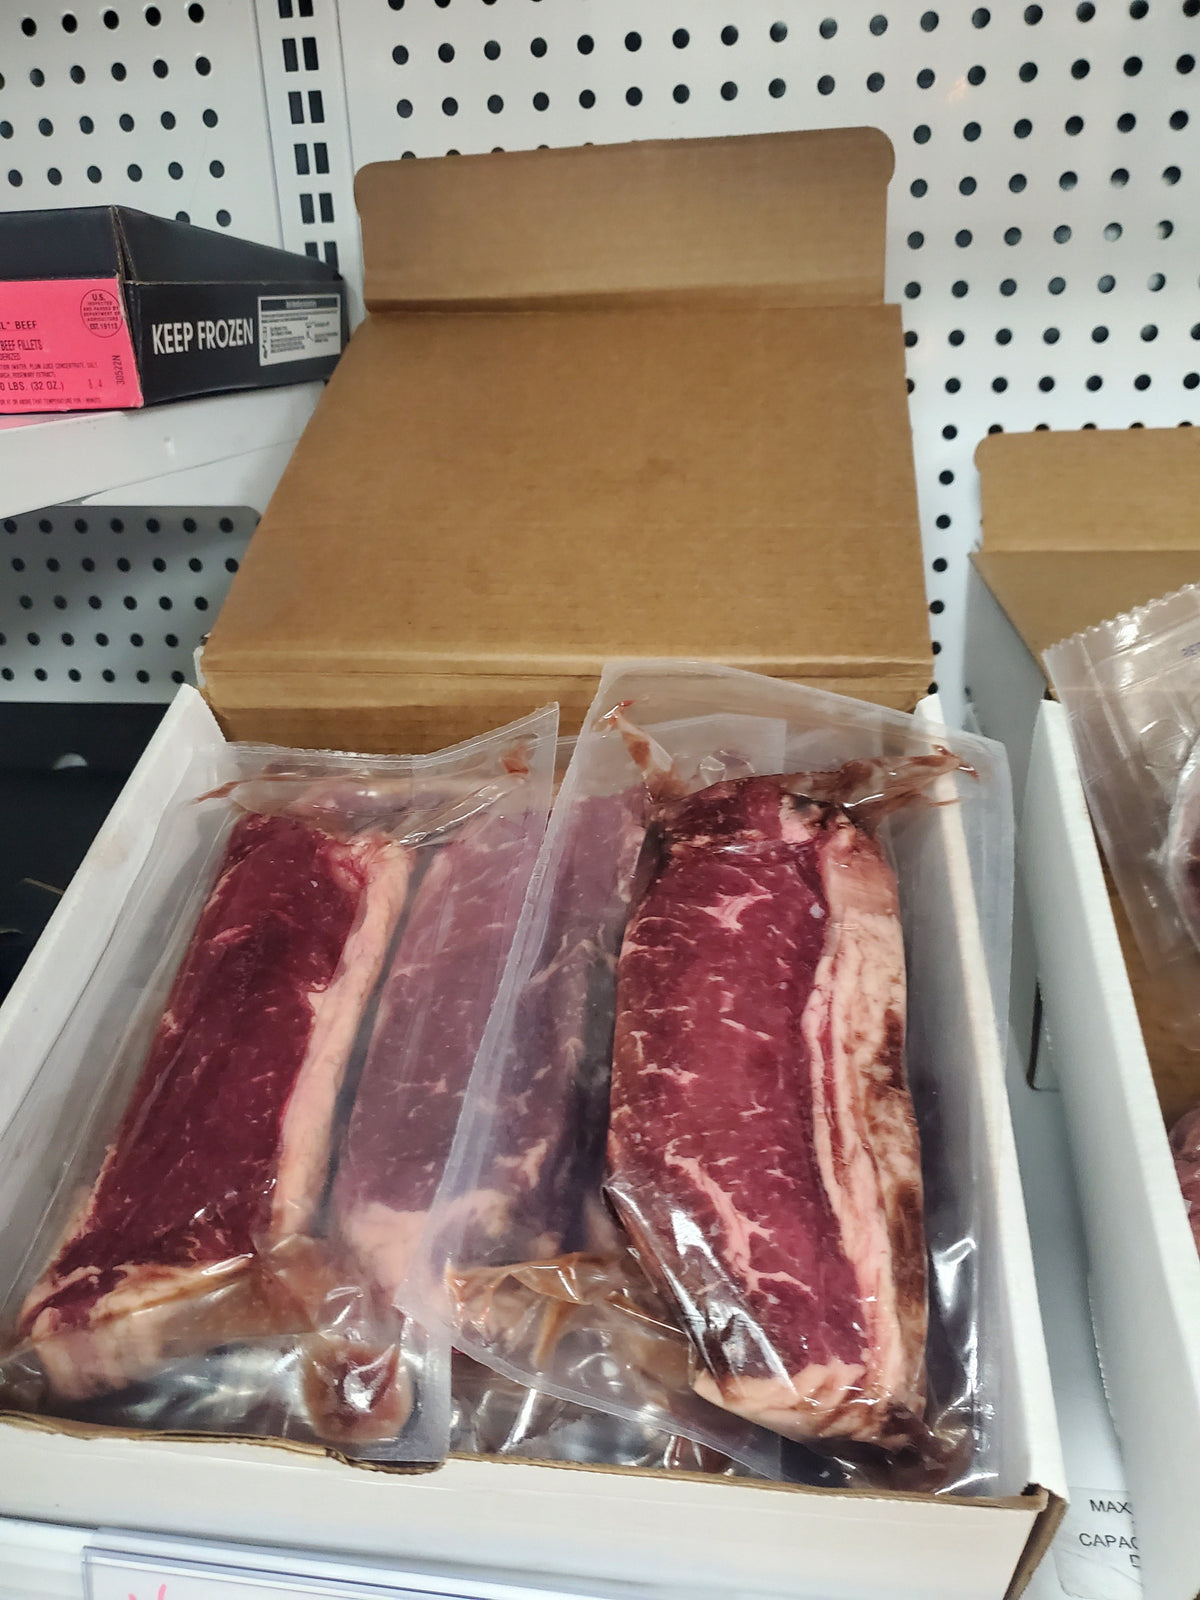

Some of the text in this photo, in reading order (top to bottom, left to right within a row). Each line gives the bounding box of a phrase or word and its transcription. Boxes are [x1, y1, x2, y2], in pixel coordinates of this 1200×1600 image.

[92, 293, 106, 301] U.S.
[15, 320, 37, 330] BEEF
[152, 322, 194, 355] KEEP
[197, 318, 254, 350] FROZEN
[17, 339, 43, 351] FILLETS
[31, 381, 44, 391] (32
[1089, 1499, 1133, 1515] MAX
